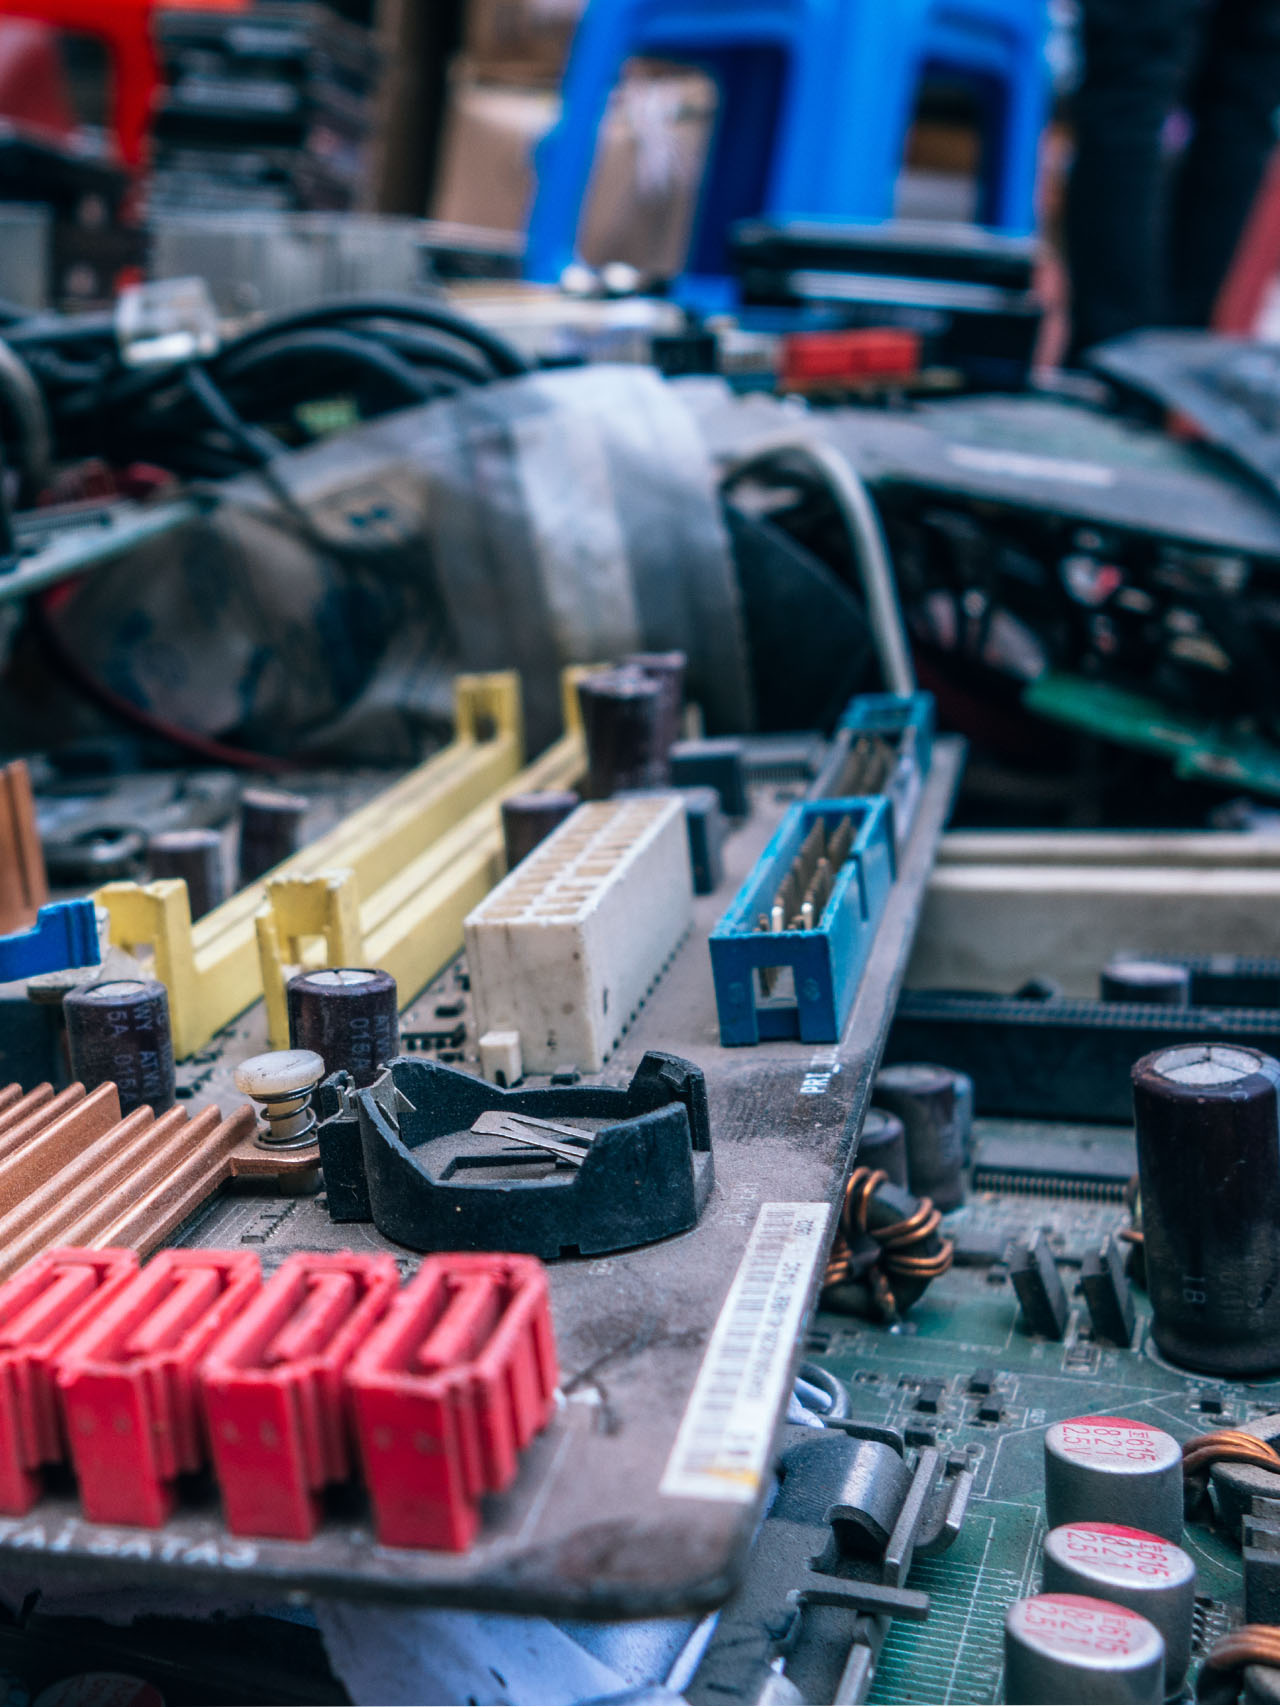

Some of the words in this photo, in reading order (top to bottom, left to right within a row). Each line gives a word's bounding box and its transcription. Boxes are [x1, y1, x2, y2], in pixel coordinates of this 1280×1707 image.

[1063, 1425, 1092, 1457] 2.5V
[1093, 1428, 1123, 1457] 821
[1067, 1531, 1104, 1566] 2.5V
[1101, 1536, 1133, 1570] 821
[1022, 1602, 1059, 1640] 2.5V
[1059, 1606, 1095, 1646] 821
